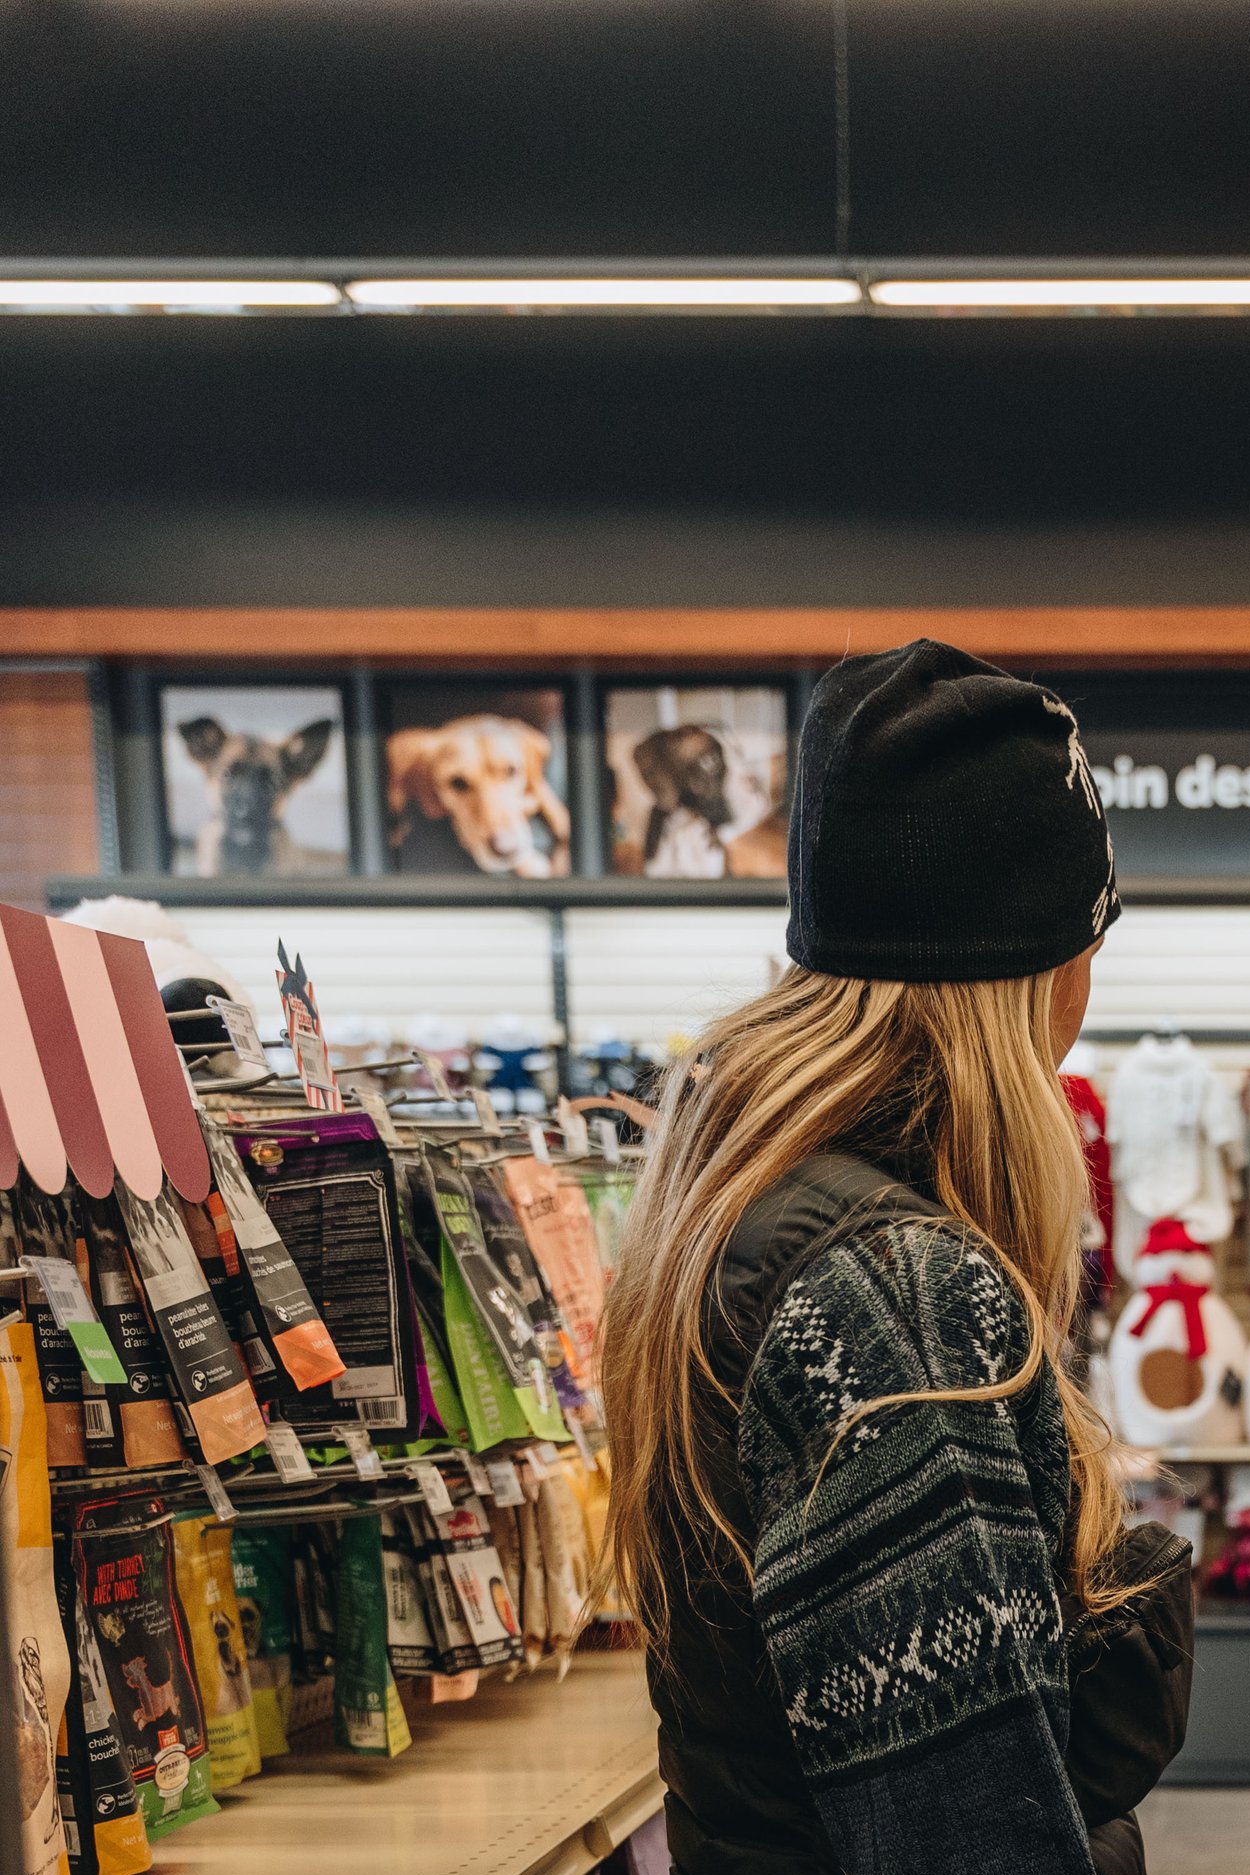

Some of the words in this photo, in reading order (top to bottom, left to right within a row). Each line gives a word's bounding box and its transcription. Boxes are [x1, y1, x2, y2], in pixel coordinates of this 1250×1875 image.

[1090, 754, 1169, 808] oin
[116, 1553, 146, 1577] TURKEY
[93, 1583, 114, 1606] AVEC
[115, 1579, 139, 1601] DINDE
